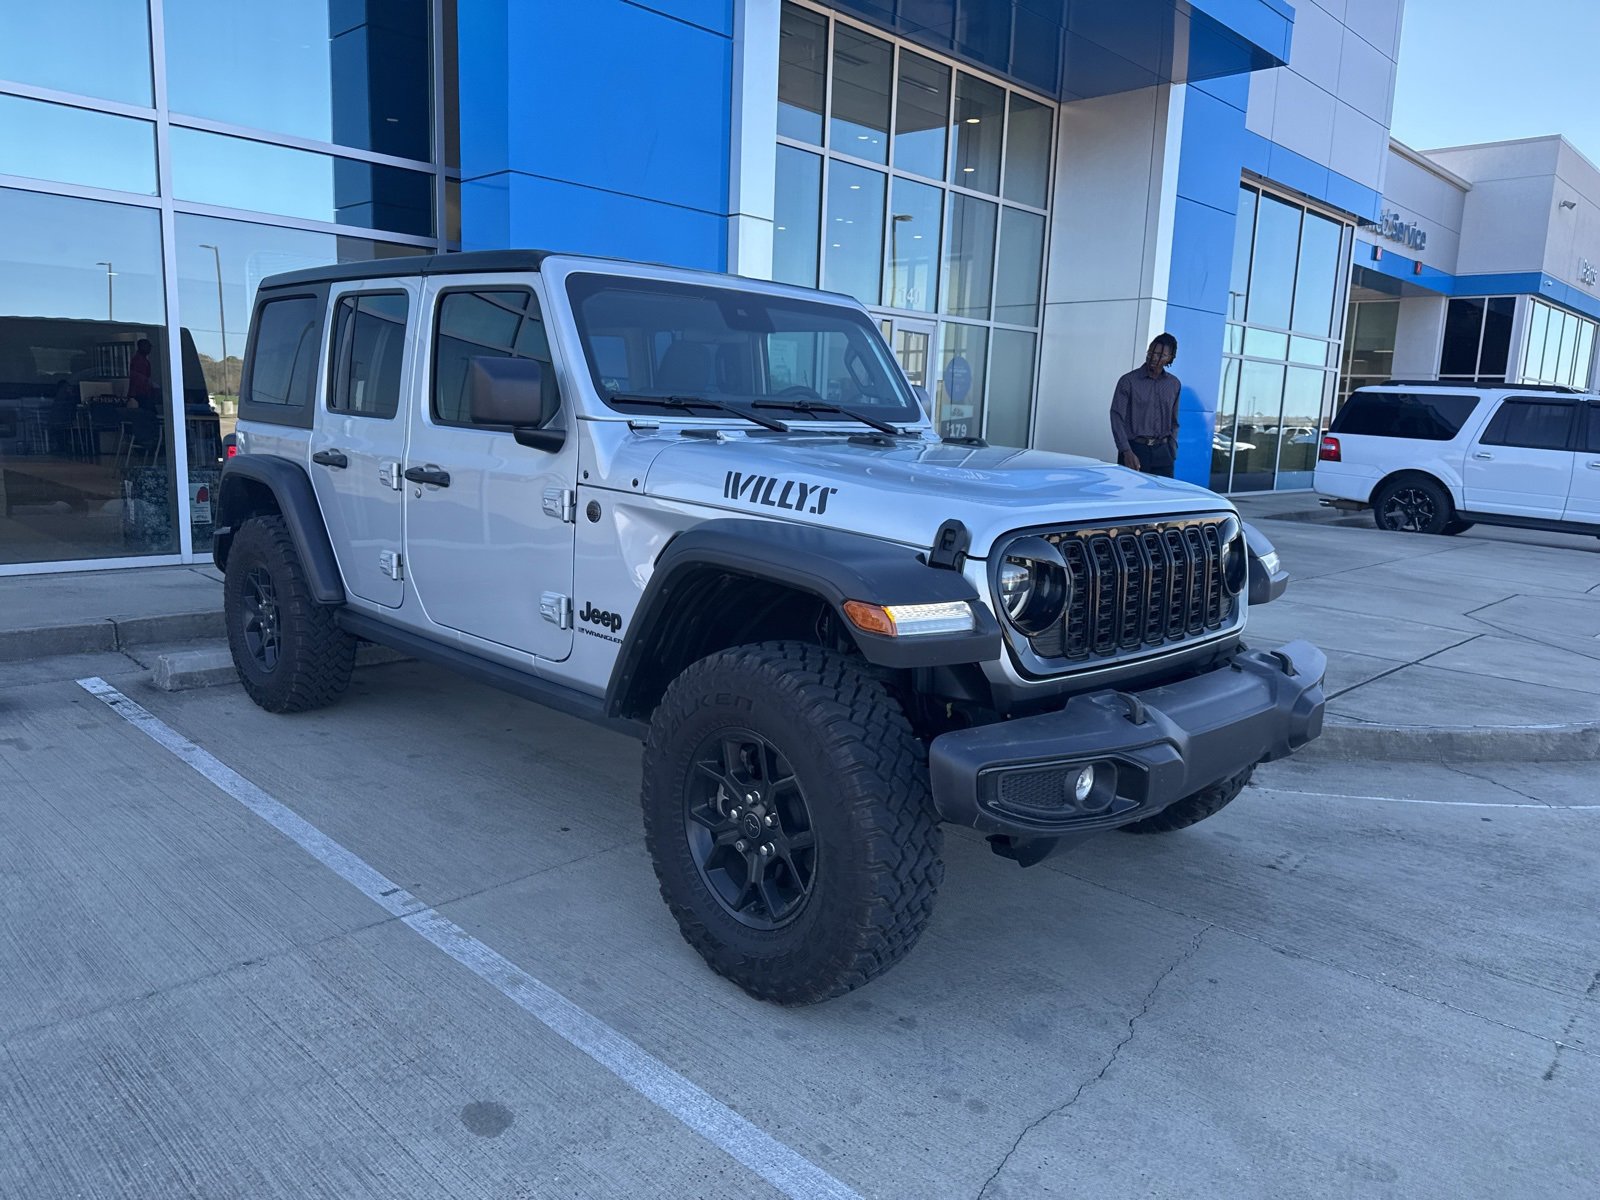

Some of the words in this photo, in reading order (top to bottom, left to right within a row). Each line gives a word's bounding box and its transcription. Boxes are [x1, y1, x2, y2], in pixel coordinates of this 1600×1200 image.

[1389, 213, 1427, 251] Service
[723, 470, 838, 515] WILLYS
[579, 600, 622, 633] Jeep
[584, 629, 623, 644] WRANGLER
